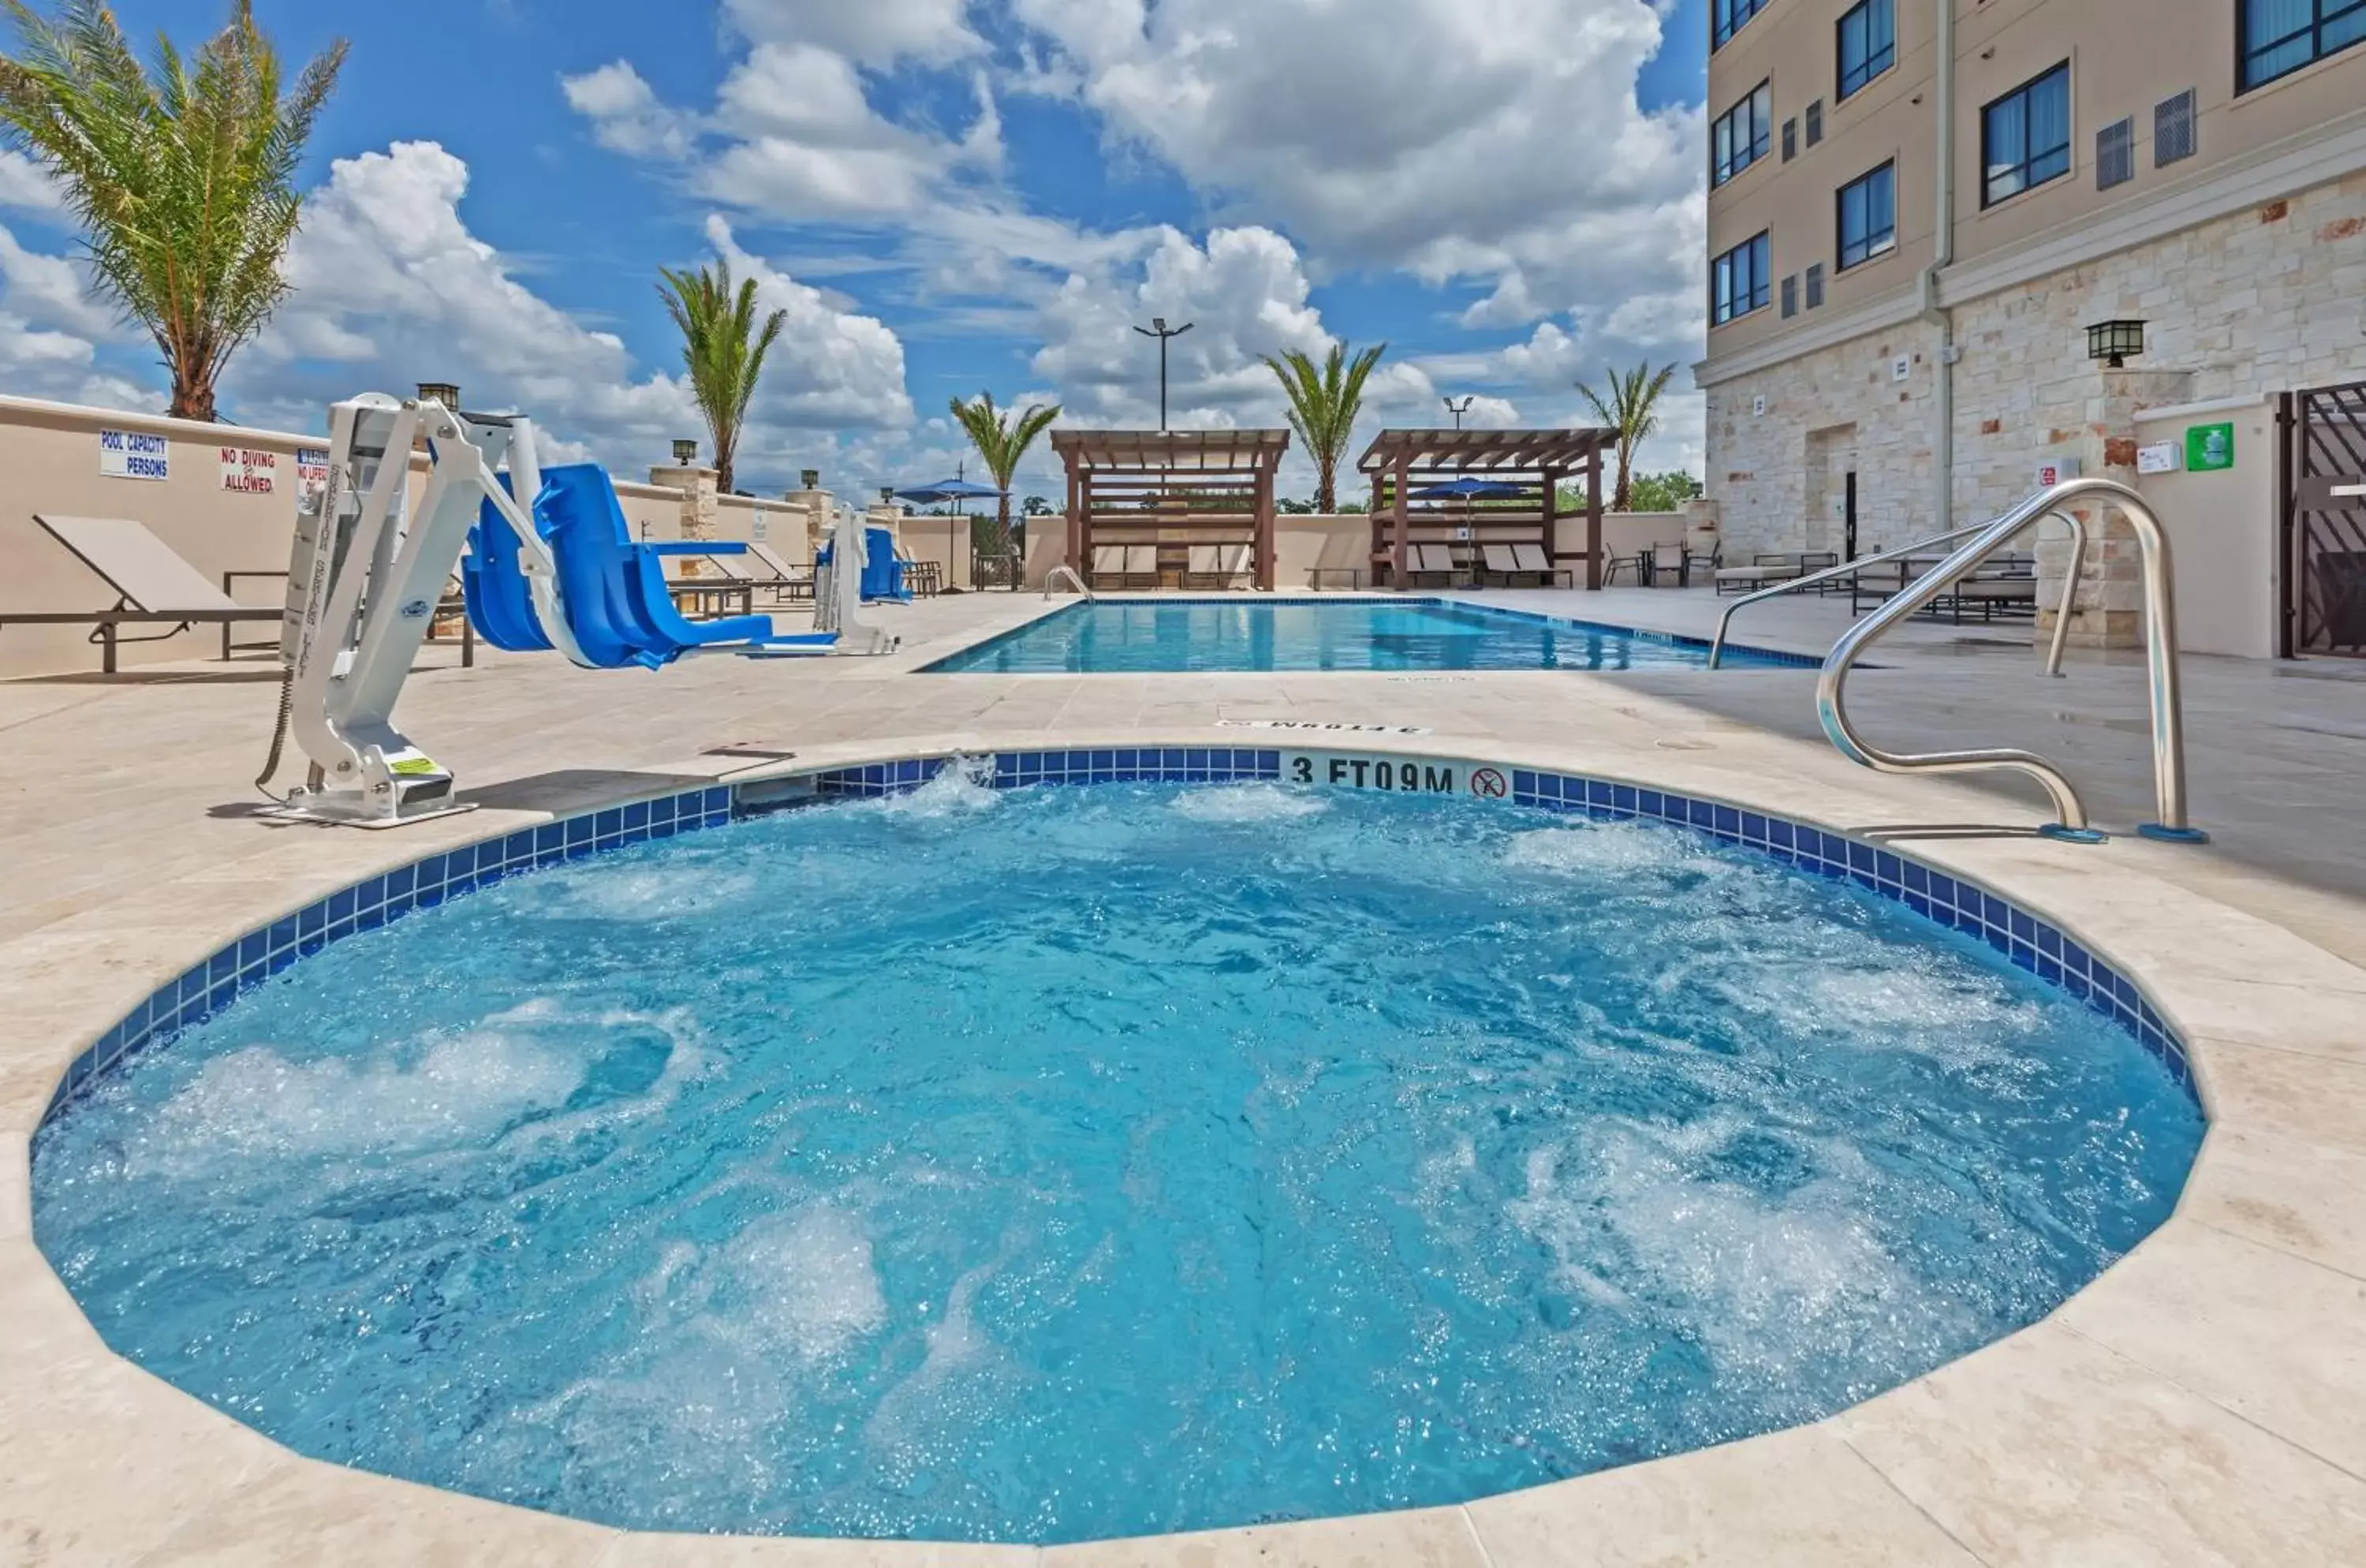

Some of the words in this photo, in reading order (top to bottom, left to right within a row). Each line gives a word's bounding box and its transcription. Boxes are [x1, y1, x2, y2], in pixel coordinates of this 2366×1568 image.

[102, 431, 123, 450] POOL
[127, 433, 166, 454] CAPACITY
[127, 456, 167, 476] PERSONS
[222, 447, 236, 464] NO
[242, 450, 275, 468] DIVING
[225, 474, 273, 492] ALLOWED
[1292, 756, 1313, 783] 3
